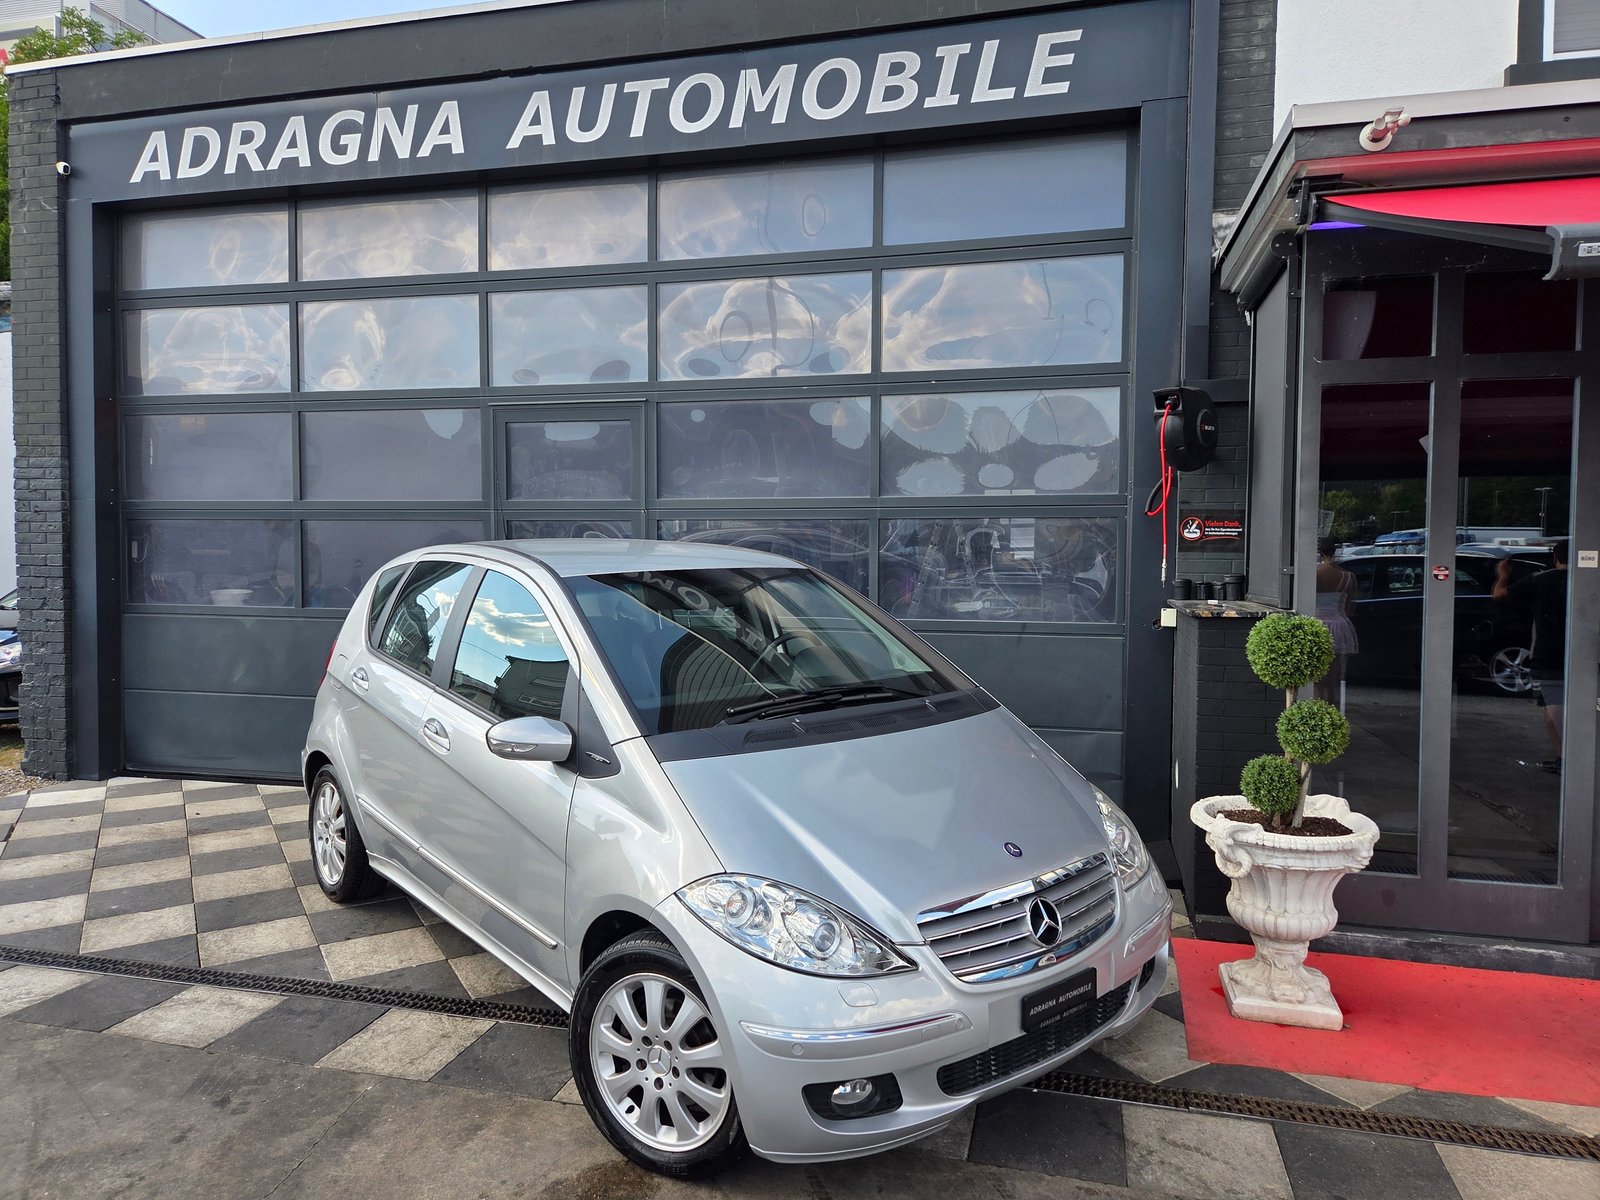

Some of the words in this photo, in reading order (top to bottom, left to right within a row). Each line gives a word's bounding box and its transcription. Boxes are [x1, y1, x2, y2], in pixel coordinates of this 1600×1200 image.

[129, 100, 465, 184] ADRAGNA
[505, 29, 1083, 149] AUTOMOBILE
[1029, 999, 1057, 1017] ADRAGNA
[1058, 983, 1092, 1003] AUTOMOBILE
